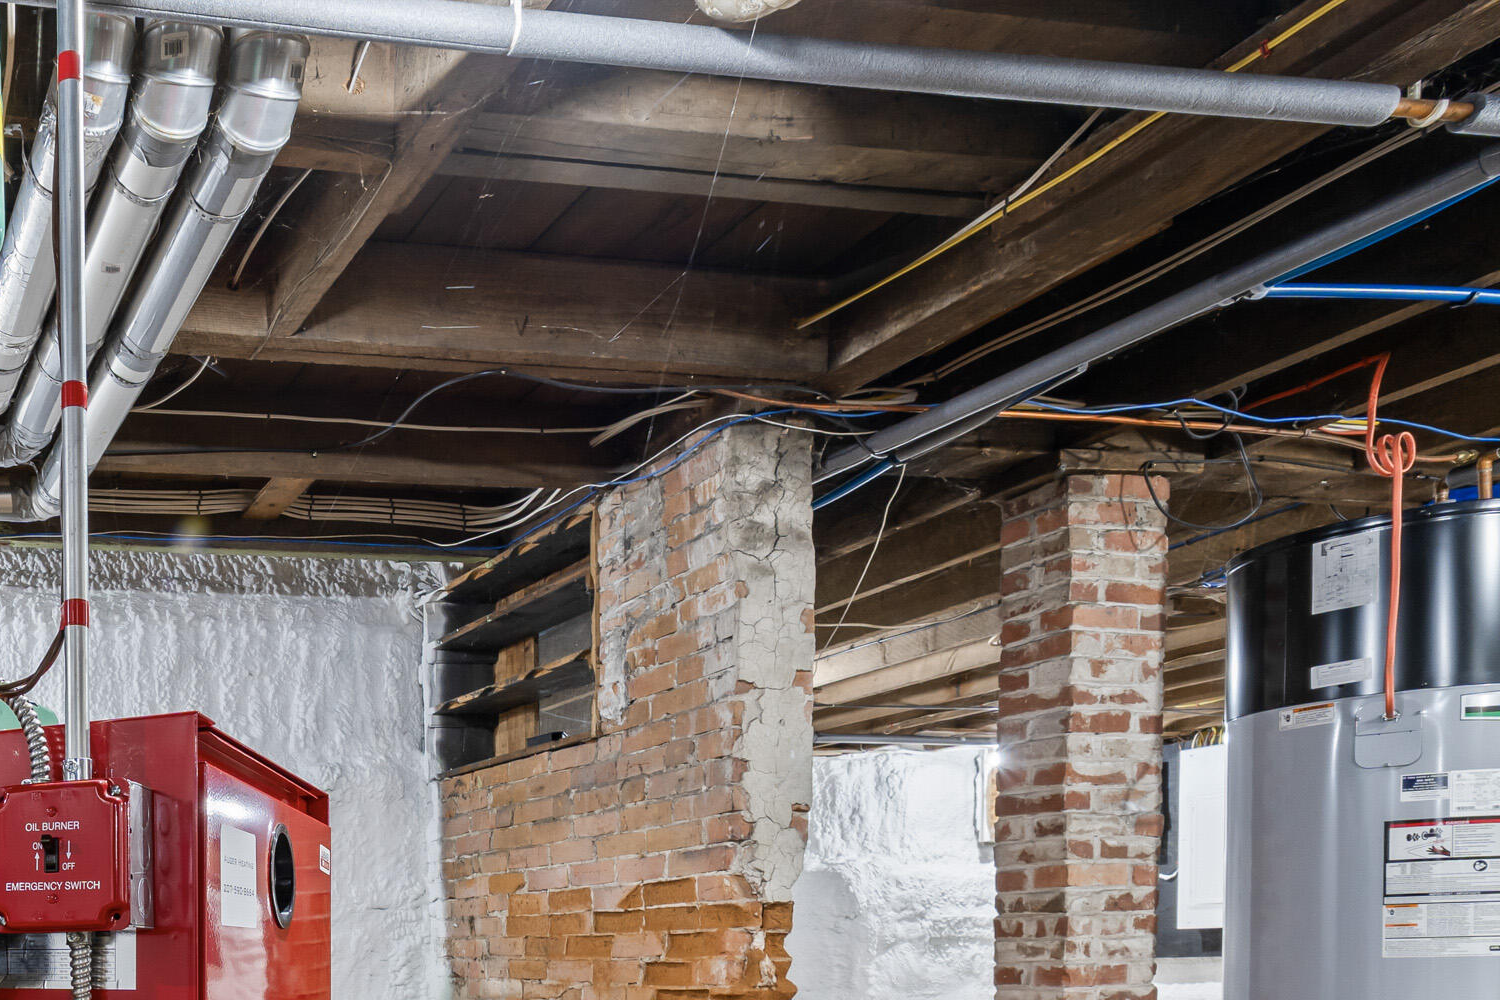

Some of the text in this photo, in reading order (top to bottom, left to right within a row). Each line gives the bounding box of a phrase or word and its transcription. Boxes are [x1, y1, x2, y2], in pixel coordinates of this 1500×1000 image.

[25, 820, 80, 832] OIL BURNER
[32, 842, 43, 850] ON
[62, 862, 76, 871] OFF
[5, 880, 101, 891] EMERGENCY SWITCH
